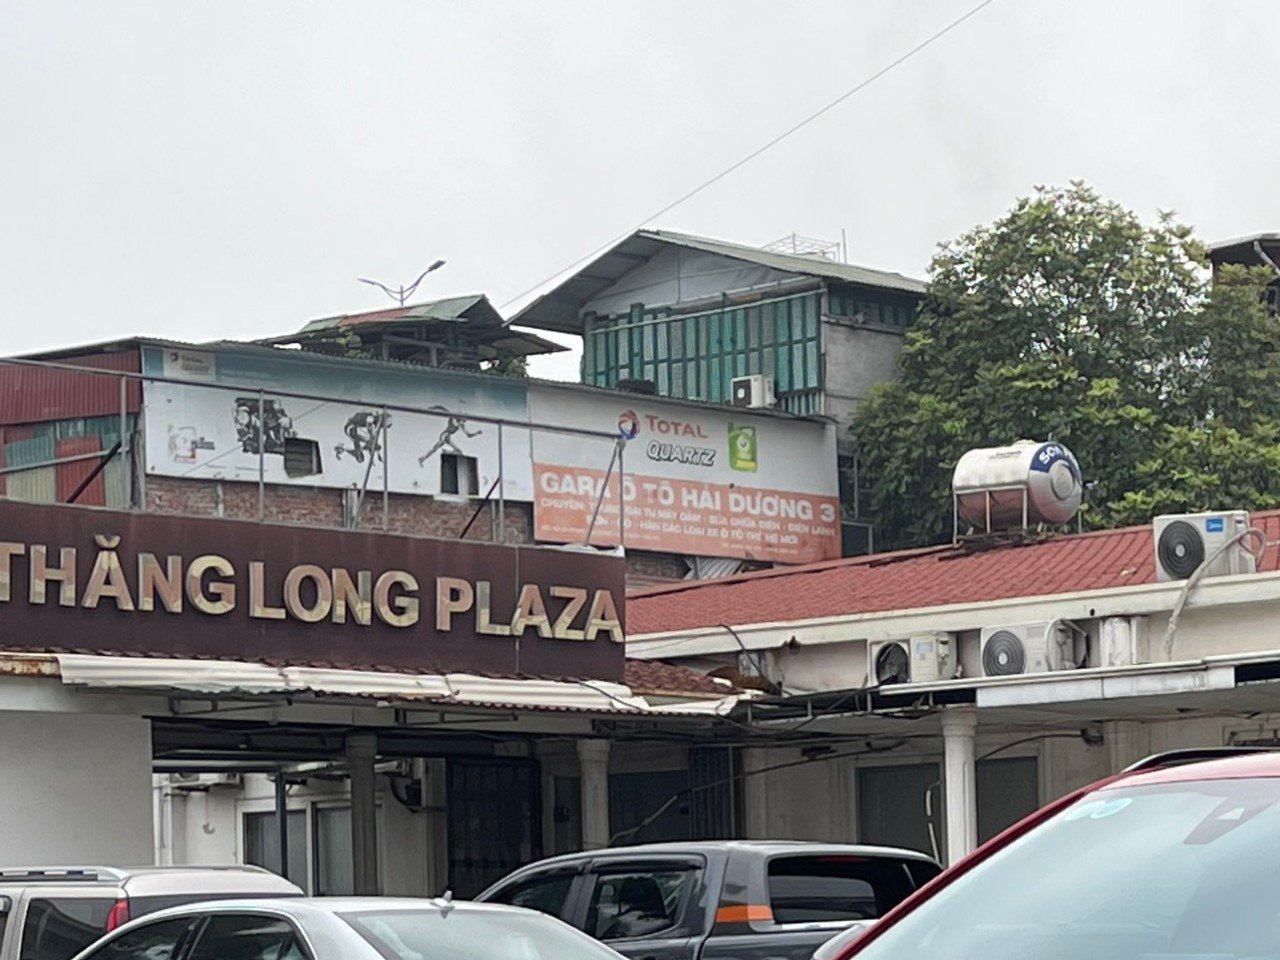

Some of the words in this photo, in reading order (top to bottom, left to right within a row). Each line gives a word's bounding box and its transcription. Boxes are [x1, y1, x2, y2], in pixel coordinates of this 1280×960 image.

[645, 414, 708, 439] TOTAL
[646, 439, 716, 467] QUARTZ
[540, 471, 612, 499] GARA
[642, 480, 675, 505] TÔ
[728, 491, 813, 520] DƯƠNG
[819, 503, 836, 522] 3
[0, 534, 236, 615] THĂNG
[249, 561, 419, 627] LONG
[436, 577, 624, 642] PLAZA
